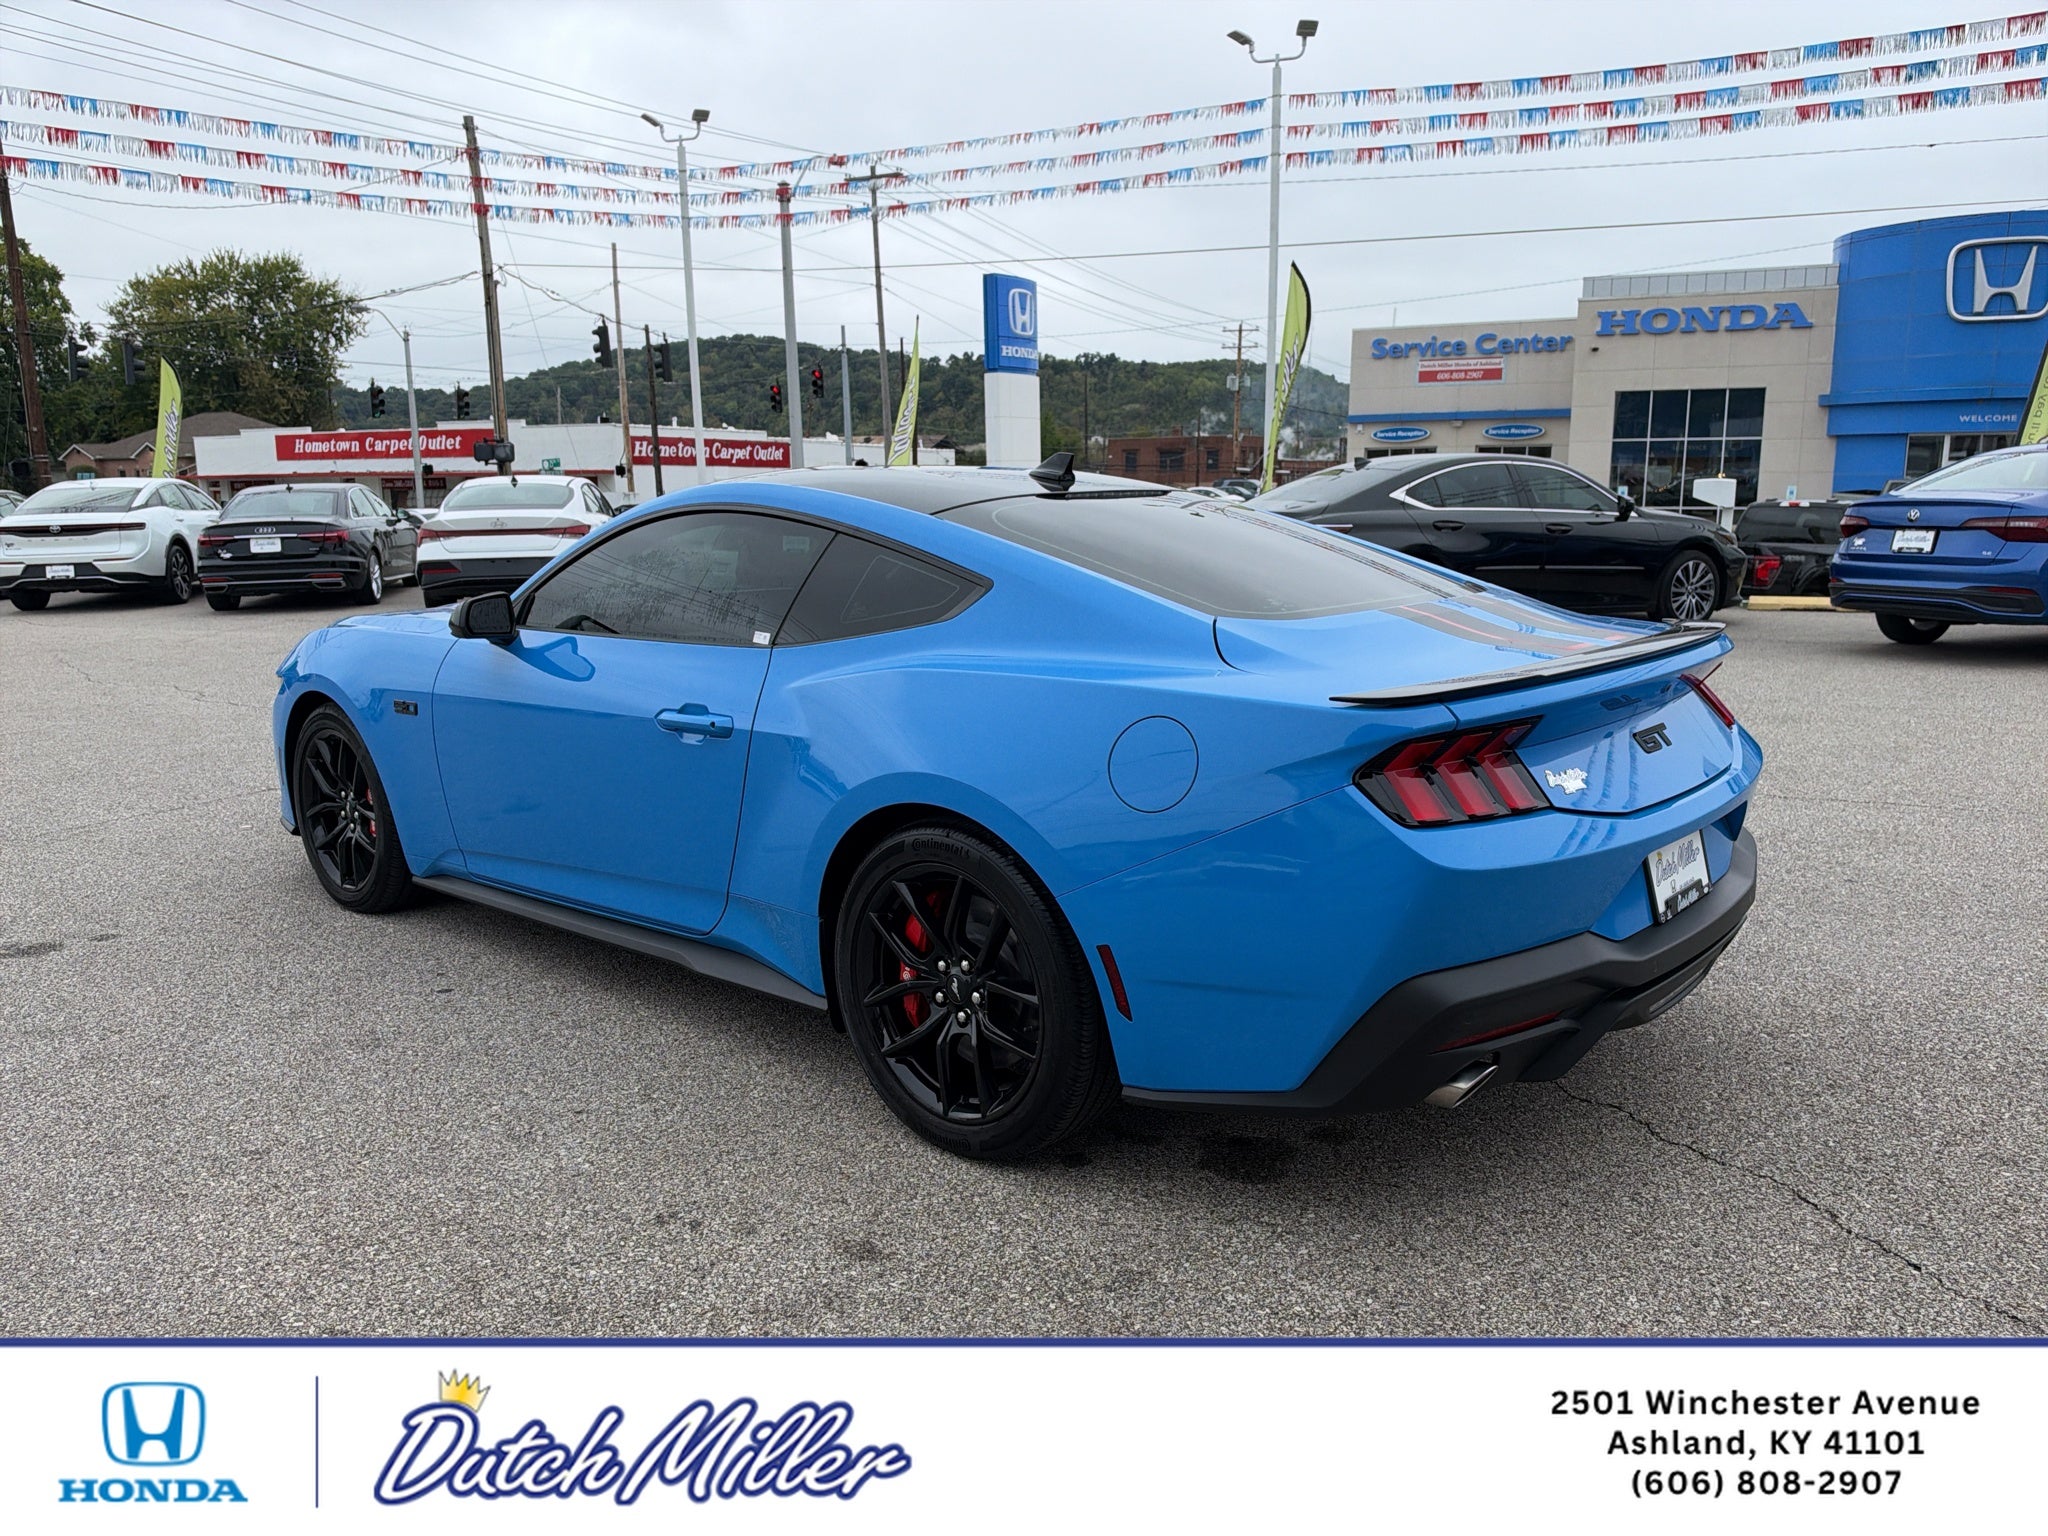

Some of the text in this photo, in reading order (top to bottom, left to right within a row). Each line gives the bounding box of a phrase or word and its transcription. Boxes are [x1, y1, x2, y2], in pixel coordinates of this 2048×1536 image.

[1596, 302, 1814, 337] HONDA
[1001, 345, 1038, 360] HONDA
[1371, 333, 1574, 359] Service Center
[1959, 414, 2018, 422] WELCOME
[294, 434, 463, 455] Hometown Carpet Outlet
[712, 442, 752, 464] Carpet
[753, 444, 785, 462] Outlet
[1632, 722, 1672, 754] GT
[912, 837, 964, 857] Continental
